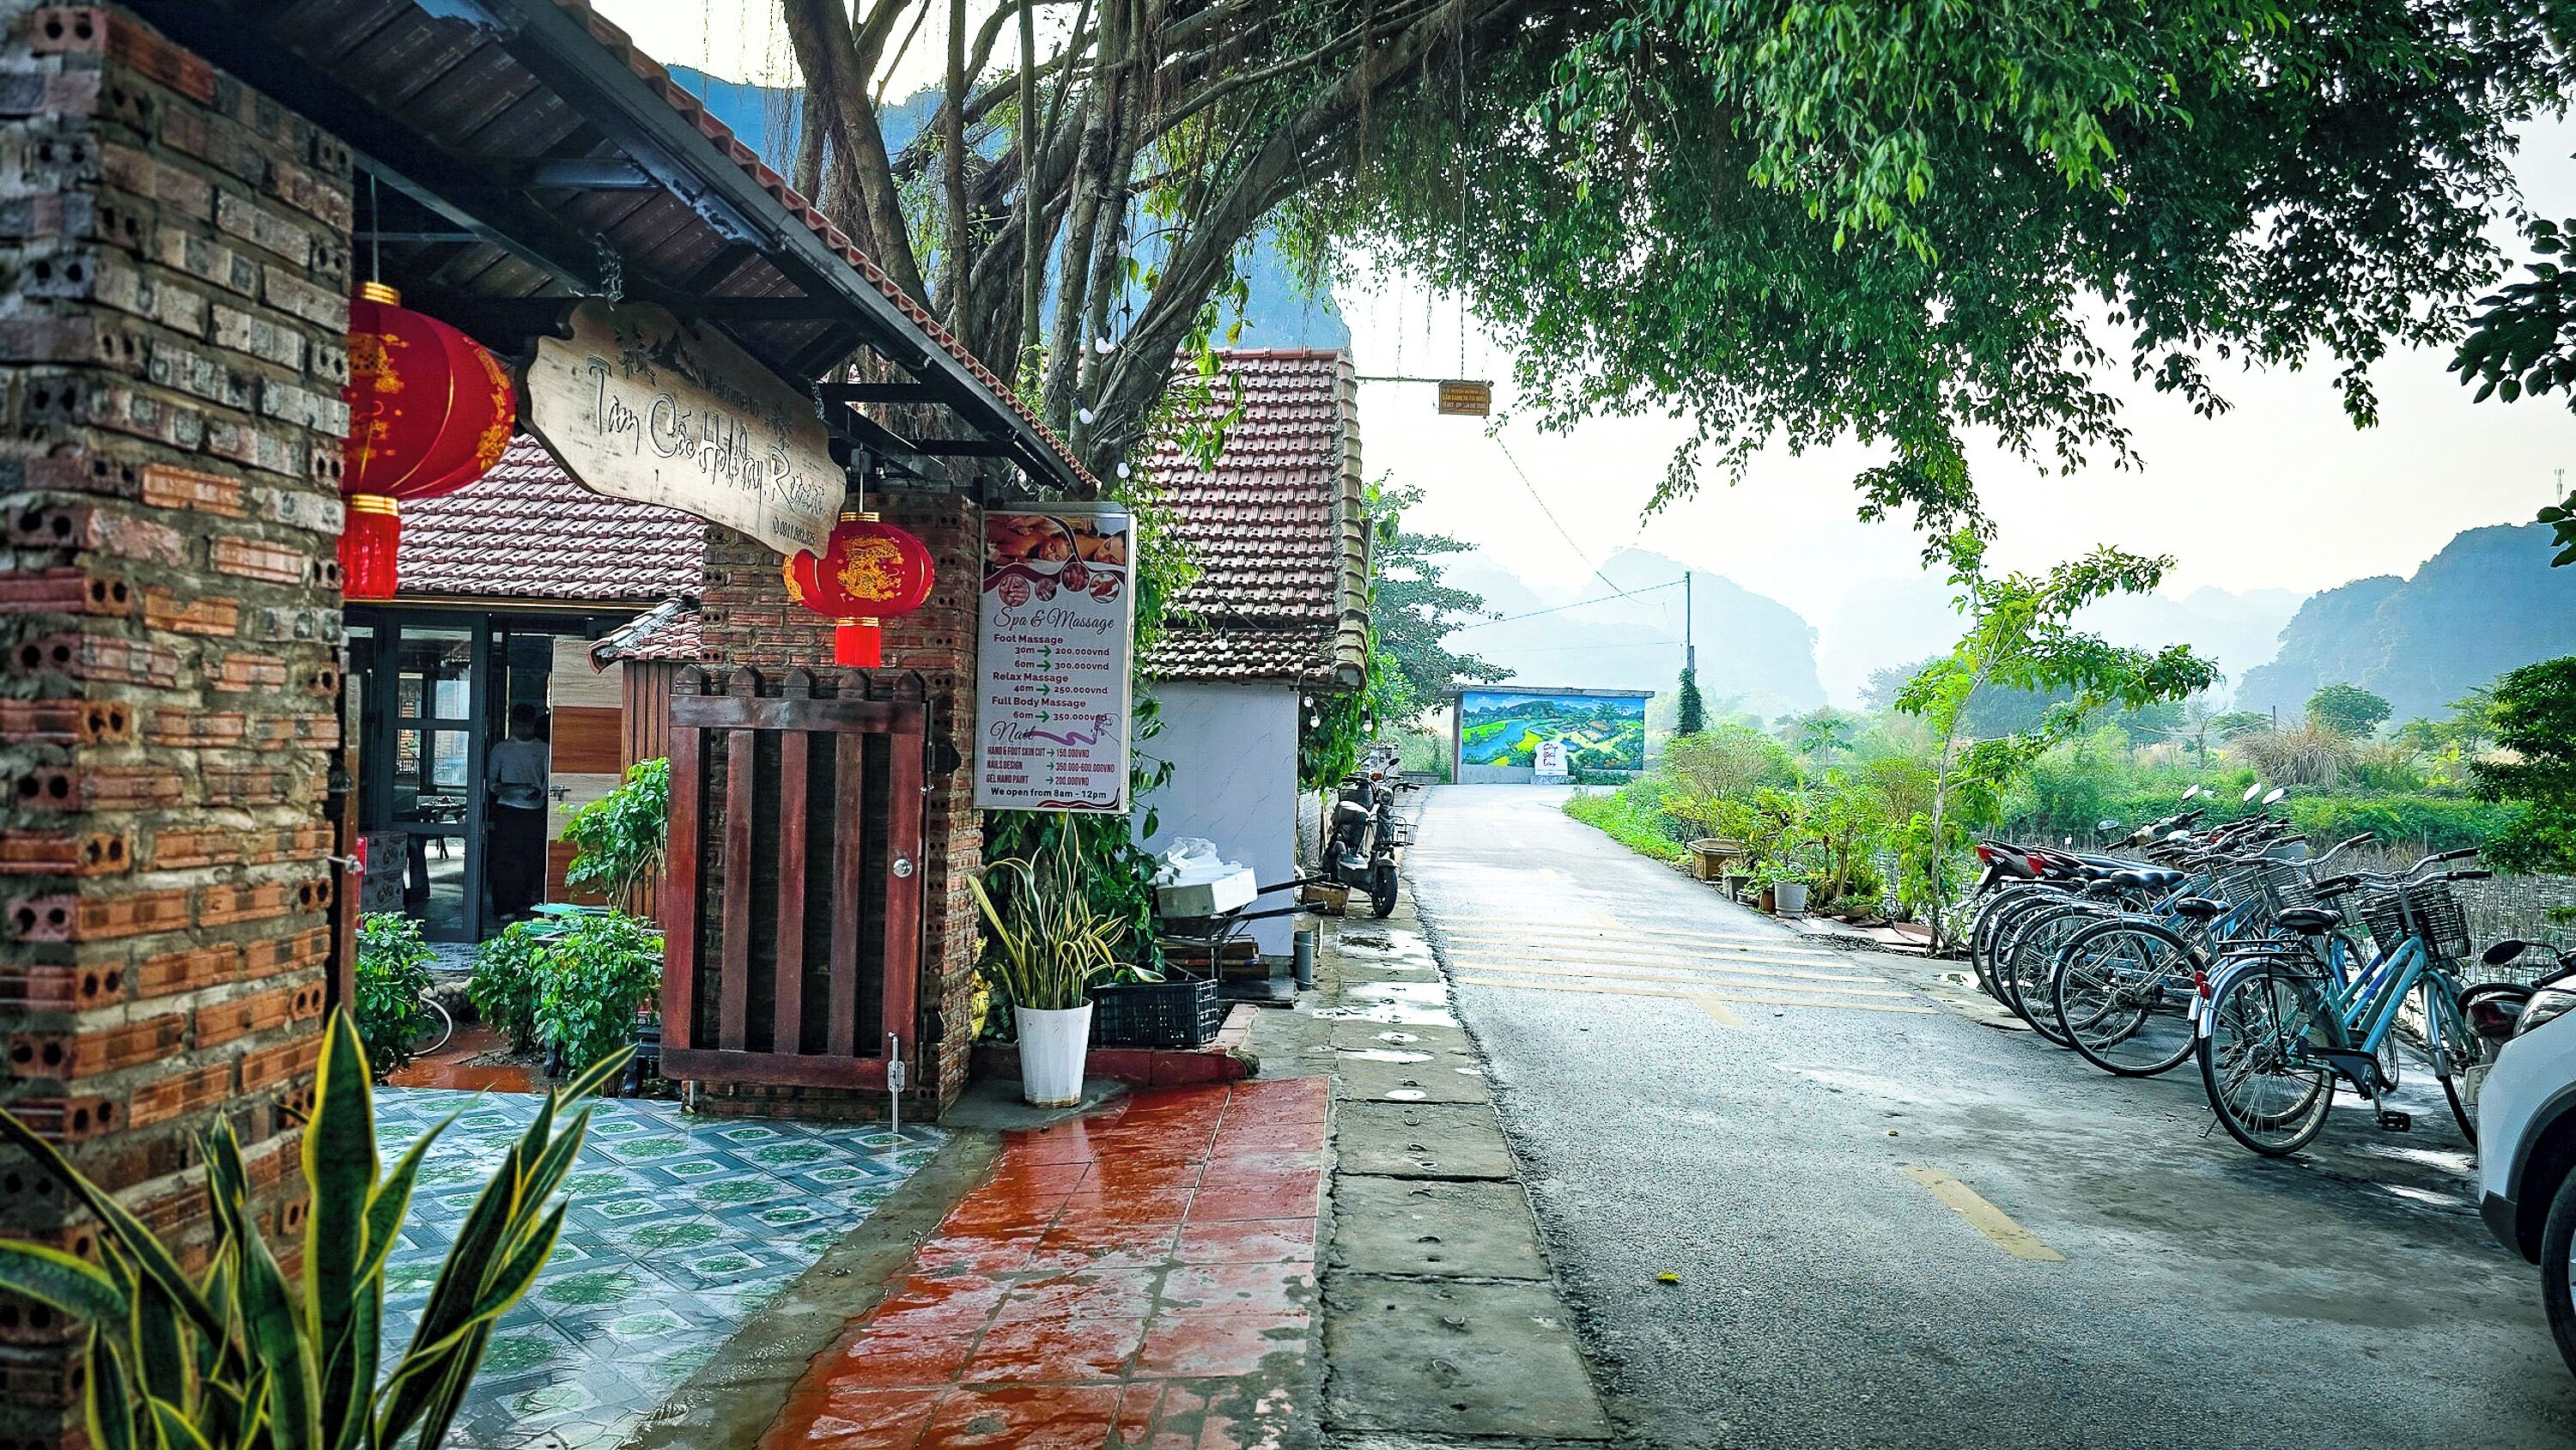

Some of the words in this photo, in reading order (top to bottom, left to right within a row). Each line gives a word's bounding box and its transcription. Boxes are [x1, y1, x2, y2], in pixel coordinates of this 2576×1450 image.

[993, 606, 1027, 631] Spa
[1030, 609, 1045, 628] &
[1047, 607, 1115, 635] Massage
[993, 634, 1017, 643] Foot
[1018, 634, 1064, 645] Massage
[1054, 647, 1109, 656] 200.000vnd
[1054, 662, 1109, 670] 300.000vnd
[993, 672, 1021, 682] Relax
[1024, 673, 1069, 684] Massage
[1054, 686, 1108, 695] 250.000vnd
[992, 696, 1012, 705] Full
[1013, 697, 1039, 707] Body
[1041, 698, 1086, 709] Massage
[1012, 711, 1033, 719] 60m
[989, 720, 1036, 743] Nail
[987, 746, 1003, 755] HAND
[1007, 746, 1021, 756] FOOT
[1021, 747, 1035, 756] SKIN
[1035, 747, 1046, 756] CUT
[987, 760, 1003, 769] NAILS
[1003, 760, 1024, 770] DESIGN
[986, 774, 996, 783] GEL
[996, 774, 1012, 784] HAND
[1012, 774, 1029, 785] PAINT
[991, 787, 1005, 796] We
[1006, 789, 1030, 798] open
[1030, 788, 1052, 797] from
[1054, 789, 1073, 798] 8am
[1082, 791, 1107, 799] 12pm
